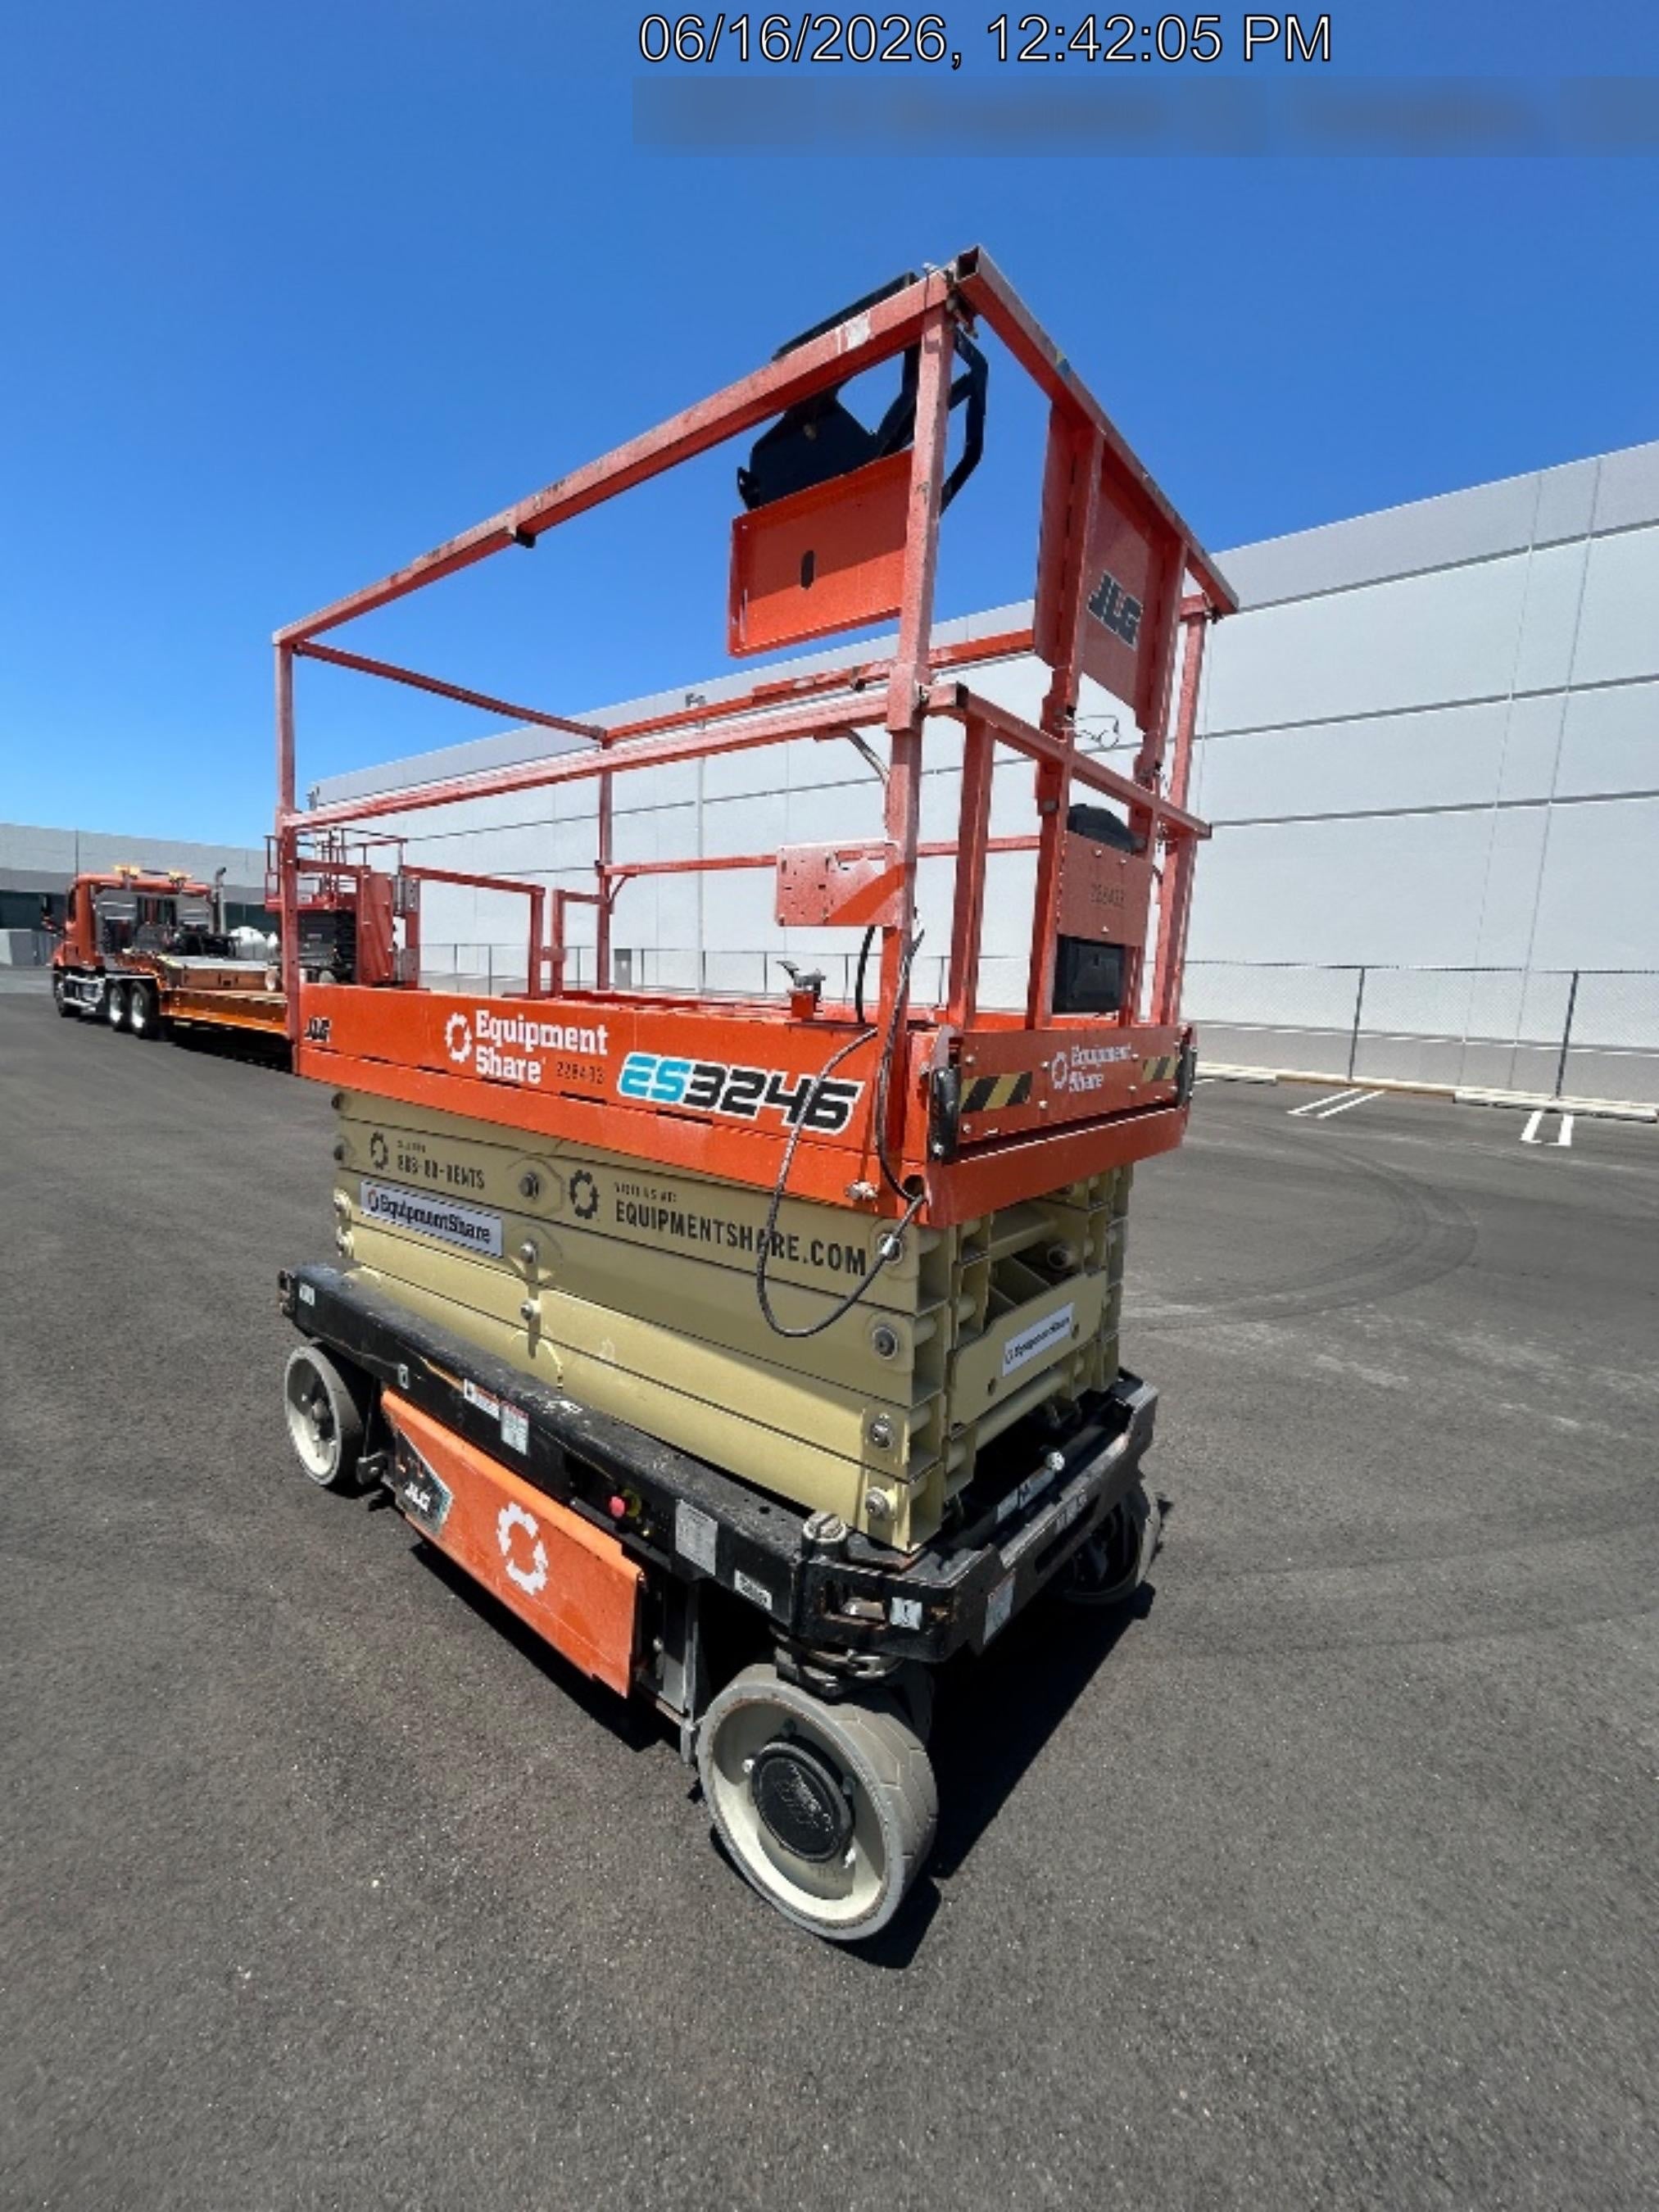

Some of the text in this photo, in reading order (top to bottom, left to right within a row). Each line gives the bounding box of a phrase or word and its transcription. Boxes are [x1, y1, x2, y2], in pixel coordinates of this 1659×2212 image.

[1089, 571, 1142, 650] JLG
[475, 1009, 609, 1055] Equipment
[475, 1045, 542, 1085] Share
[619, 1052, 865, 1135] ES3246
[616, 1199, 866, 1276] EQUIPMENTSHARE.COM
